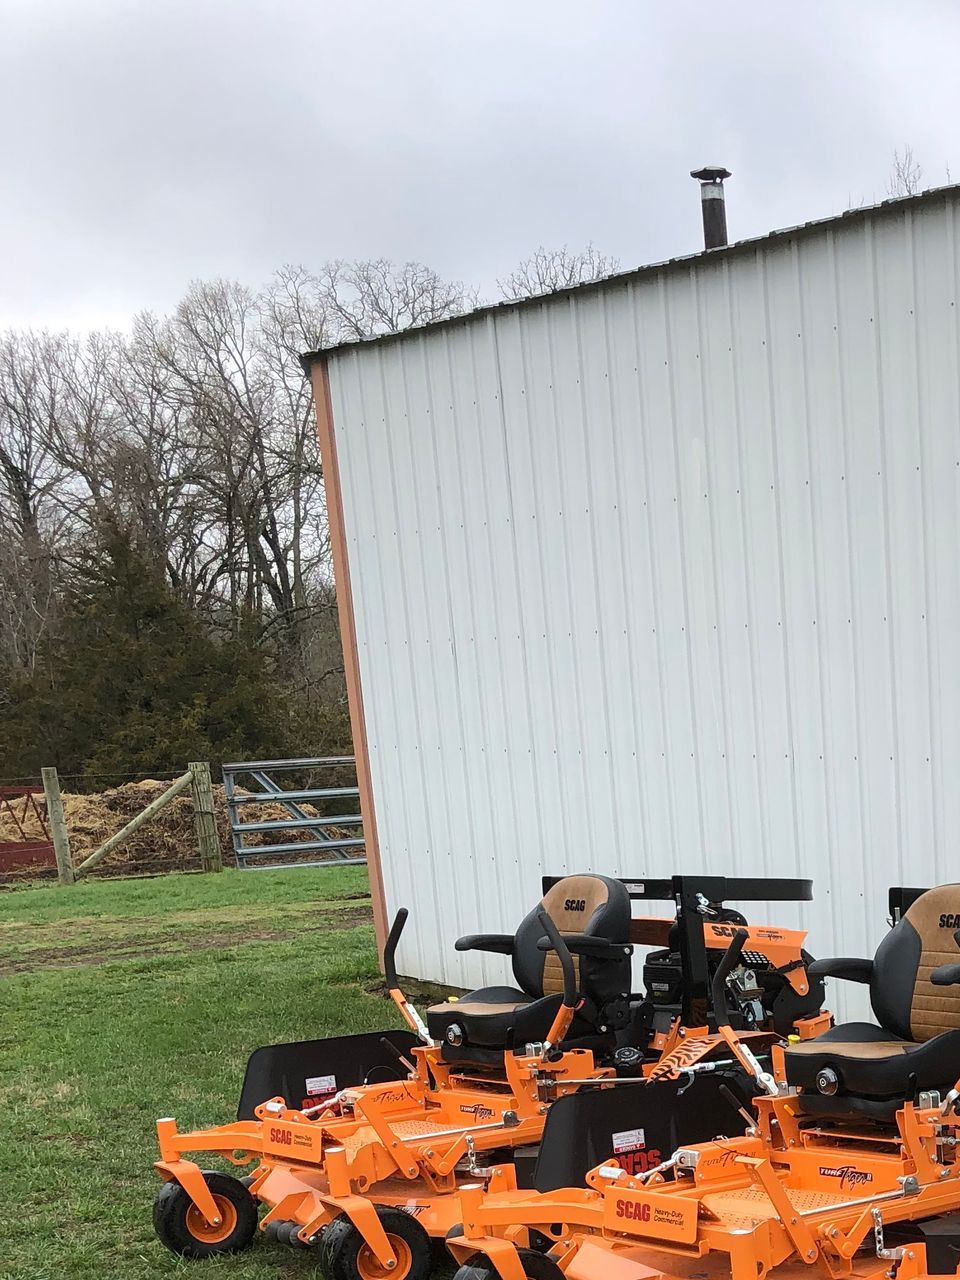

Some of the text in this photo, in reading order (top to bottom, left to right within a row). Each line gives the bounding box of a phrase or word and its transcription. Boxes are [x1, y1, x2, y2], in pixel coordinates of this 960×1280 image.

[564, 899, 586, 911] SCAG
[711, 925, 741, 938] SCA
[270, 1127, 292, 1146] SCAG
[617, 1149, 661, 1175] SCA
[820, 1167, 843, 1177] TURF
[836, 1166, 867, 1191] Tiger
[616, 1199, 651, 1222] SCAG
[654, 1207, 684, 1219] Heavy-Duty
[653, 1214, 685, 1226] Commercial
